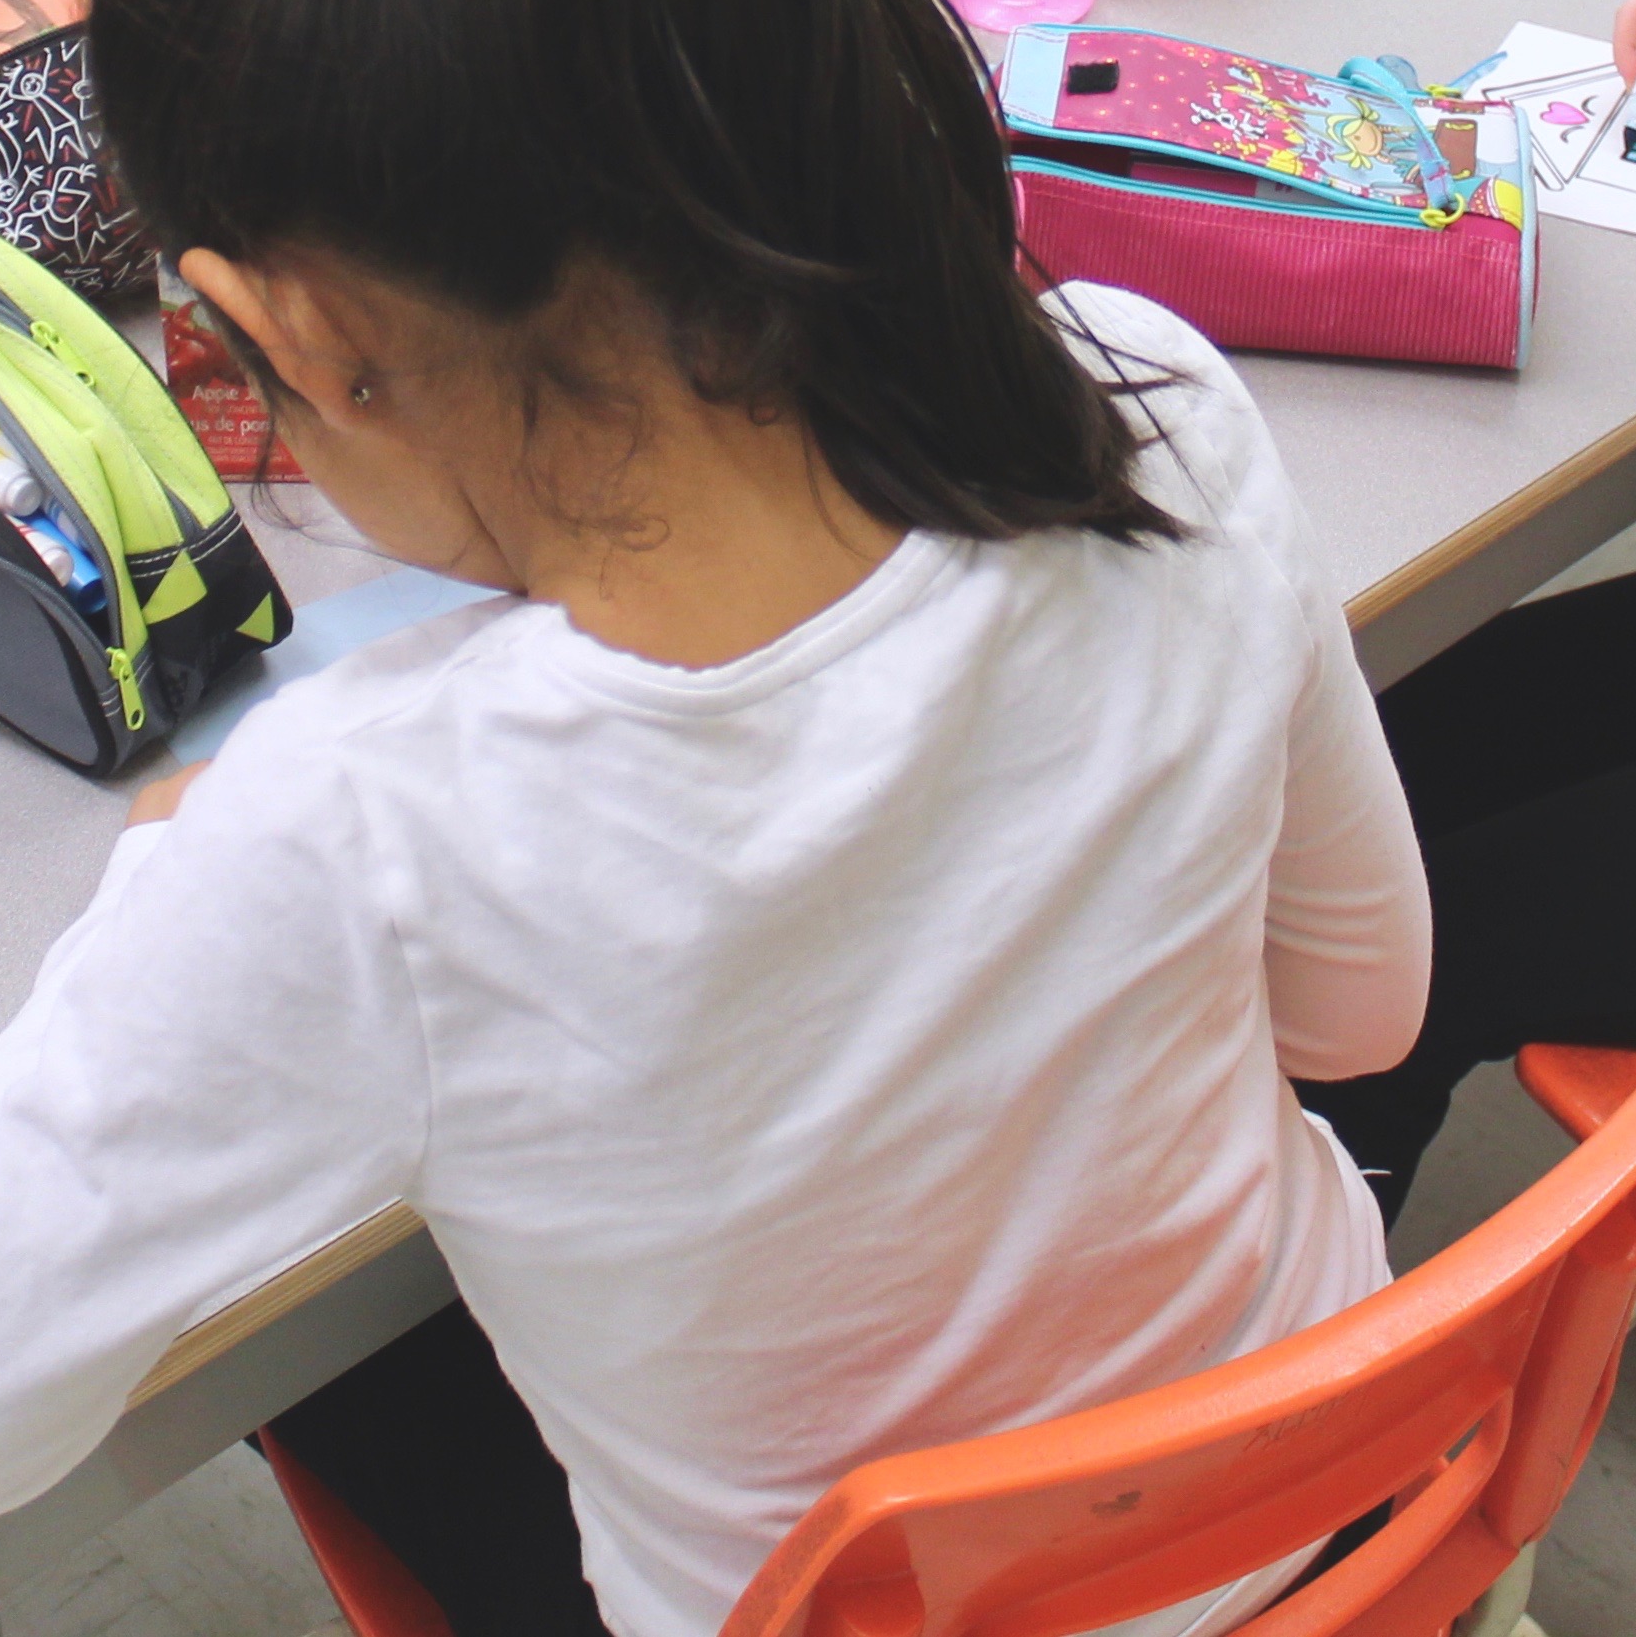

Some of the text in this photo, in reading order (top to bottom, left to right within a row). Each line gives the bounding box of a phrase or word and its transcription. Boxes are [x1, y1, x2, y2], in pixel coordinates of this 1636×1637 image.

[192, 385, 239, 402] Apple
[190, 418, 209, 431] us
[215, 415, 234, 431] de
